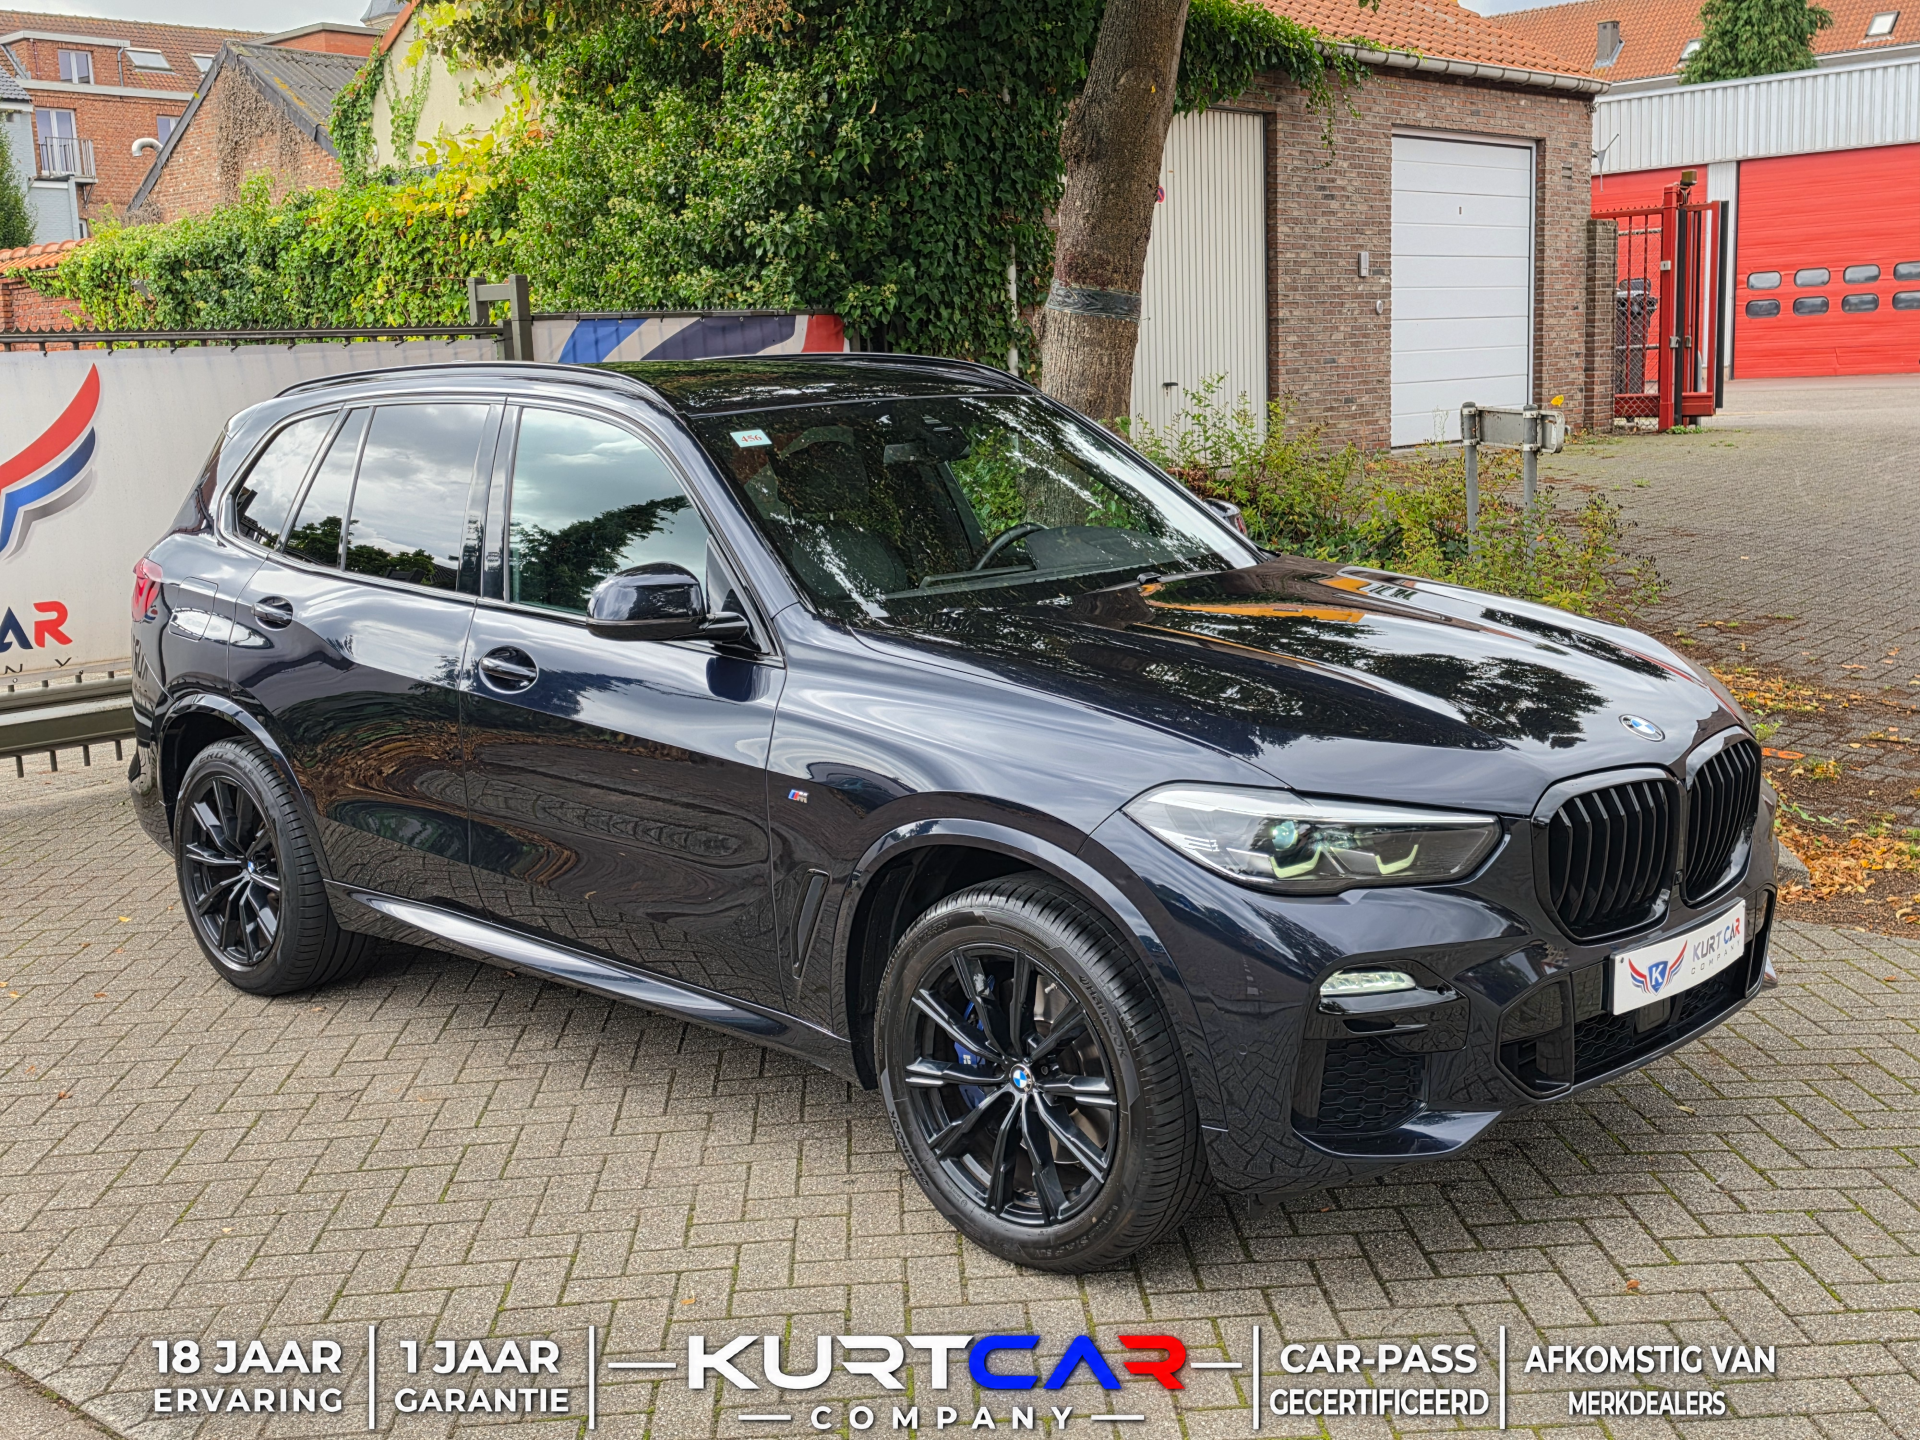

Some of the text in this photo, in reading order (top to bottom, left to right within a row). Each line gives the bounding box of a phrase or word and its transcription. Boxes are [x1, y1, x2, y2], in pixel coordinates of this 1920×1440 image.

[741, 434, 762, 442] 456
[1692, 917, 1740, 963] KURT CAR
[1691, 940, 1740, 975] COMPANY
[1651, 963, 1665, 986] K
